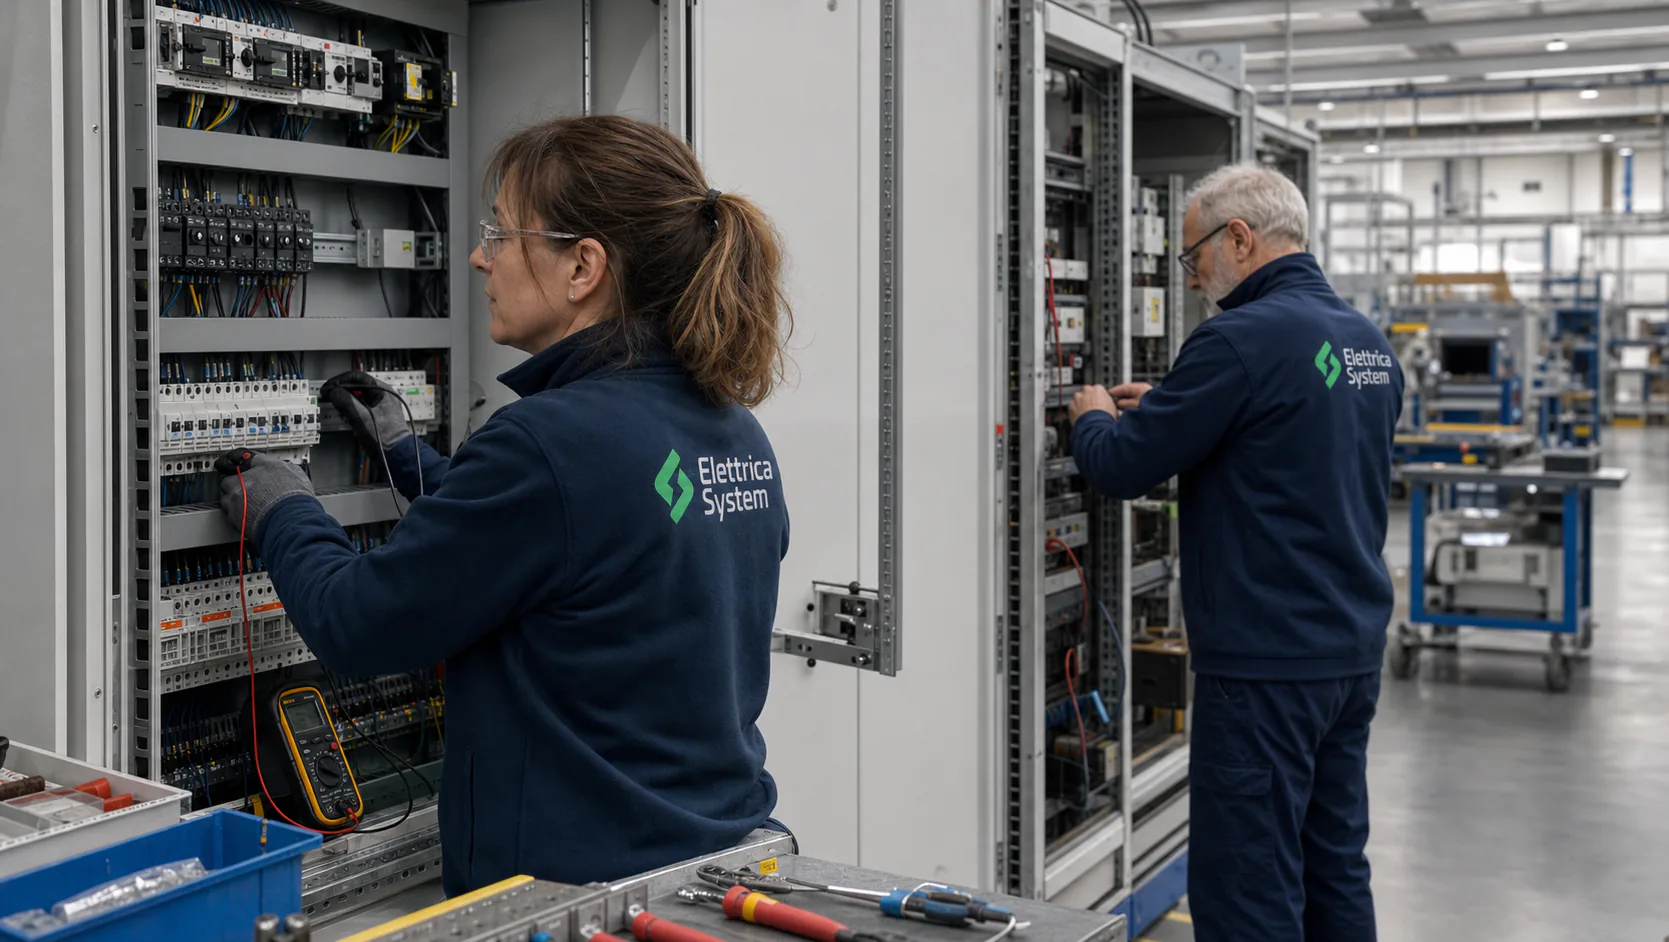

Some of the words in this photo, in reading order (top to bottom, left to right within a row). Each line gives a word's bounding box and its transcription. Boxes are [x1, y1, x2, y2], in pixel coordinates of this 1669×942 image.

[1343, 348, 1392, 367] Elettrica
[1346, 367, 1390, 390] System
[698, 455, 773, 485] Elettrica
[702, 486, 769, 522] System
